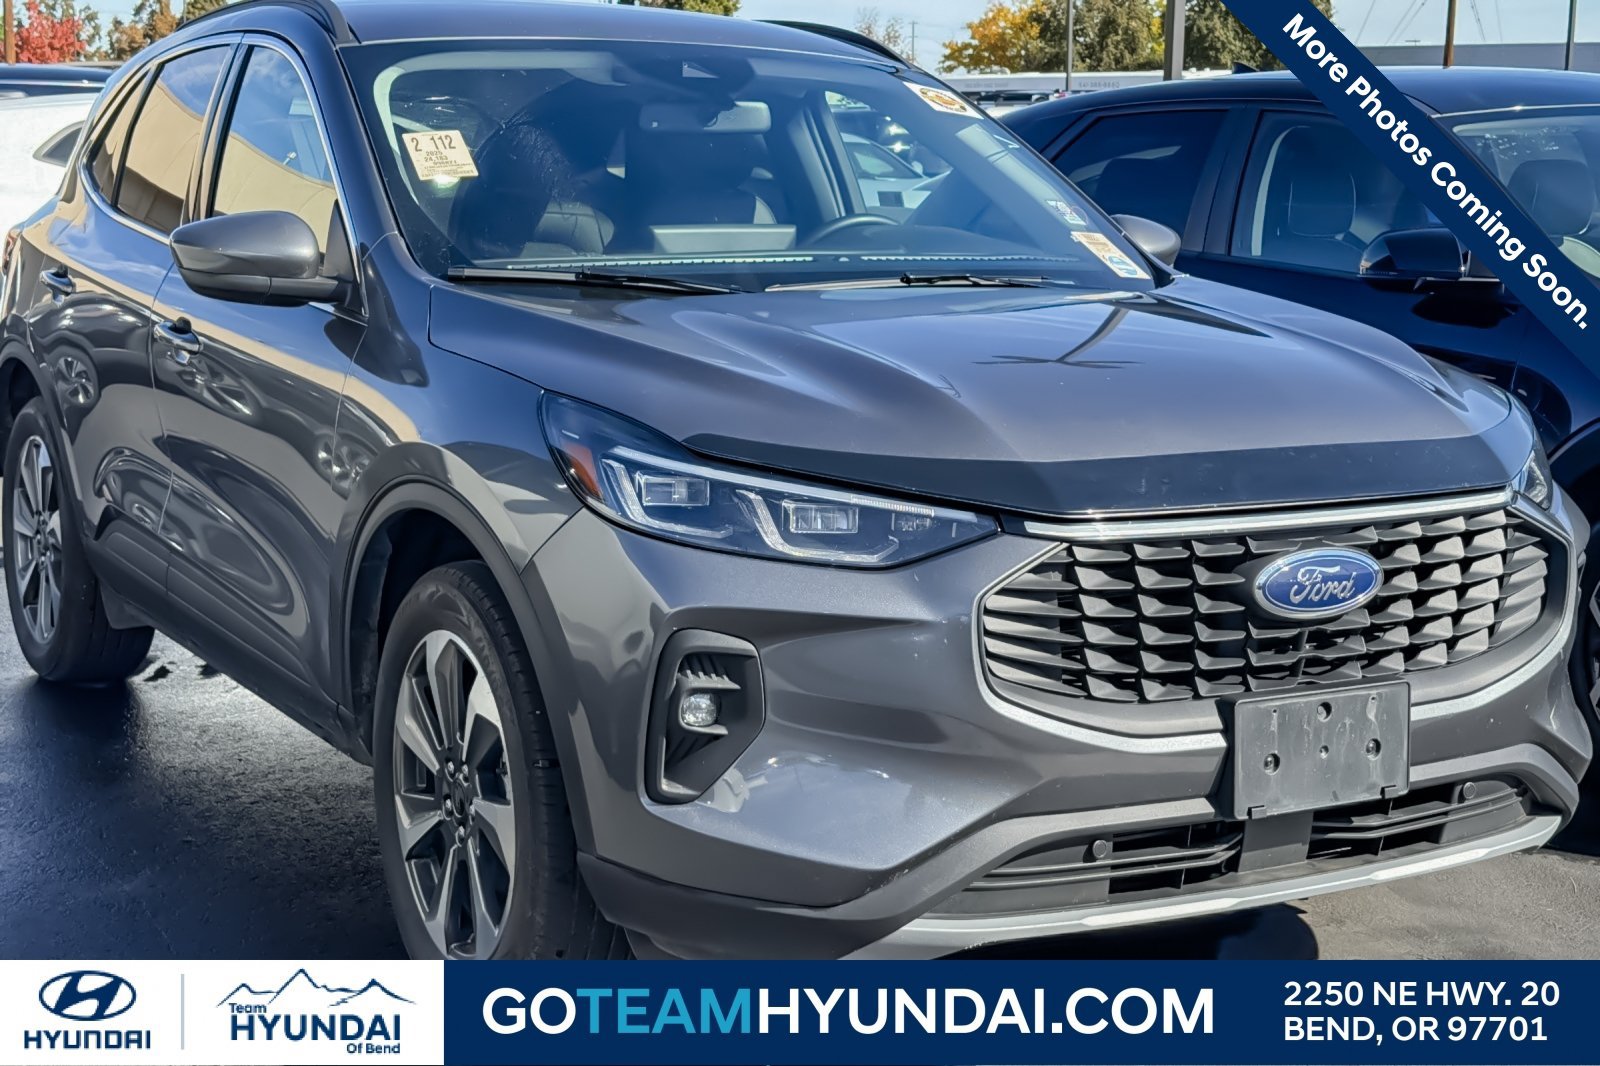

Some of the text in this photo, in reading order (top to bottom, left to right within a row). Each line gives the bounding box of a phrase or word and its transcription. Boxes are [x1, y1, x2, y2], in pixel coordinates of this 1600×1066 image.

[411, 134, 456, 152] 2 112
[1289, 565, 1357, 604] Ford
